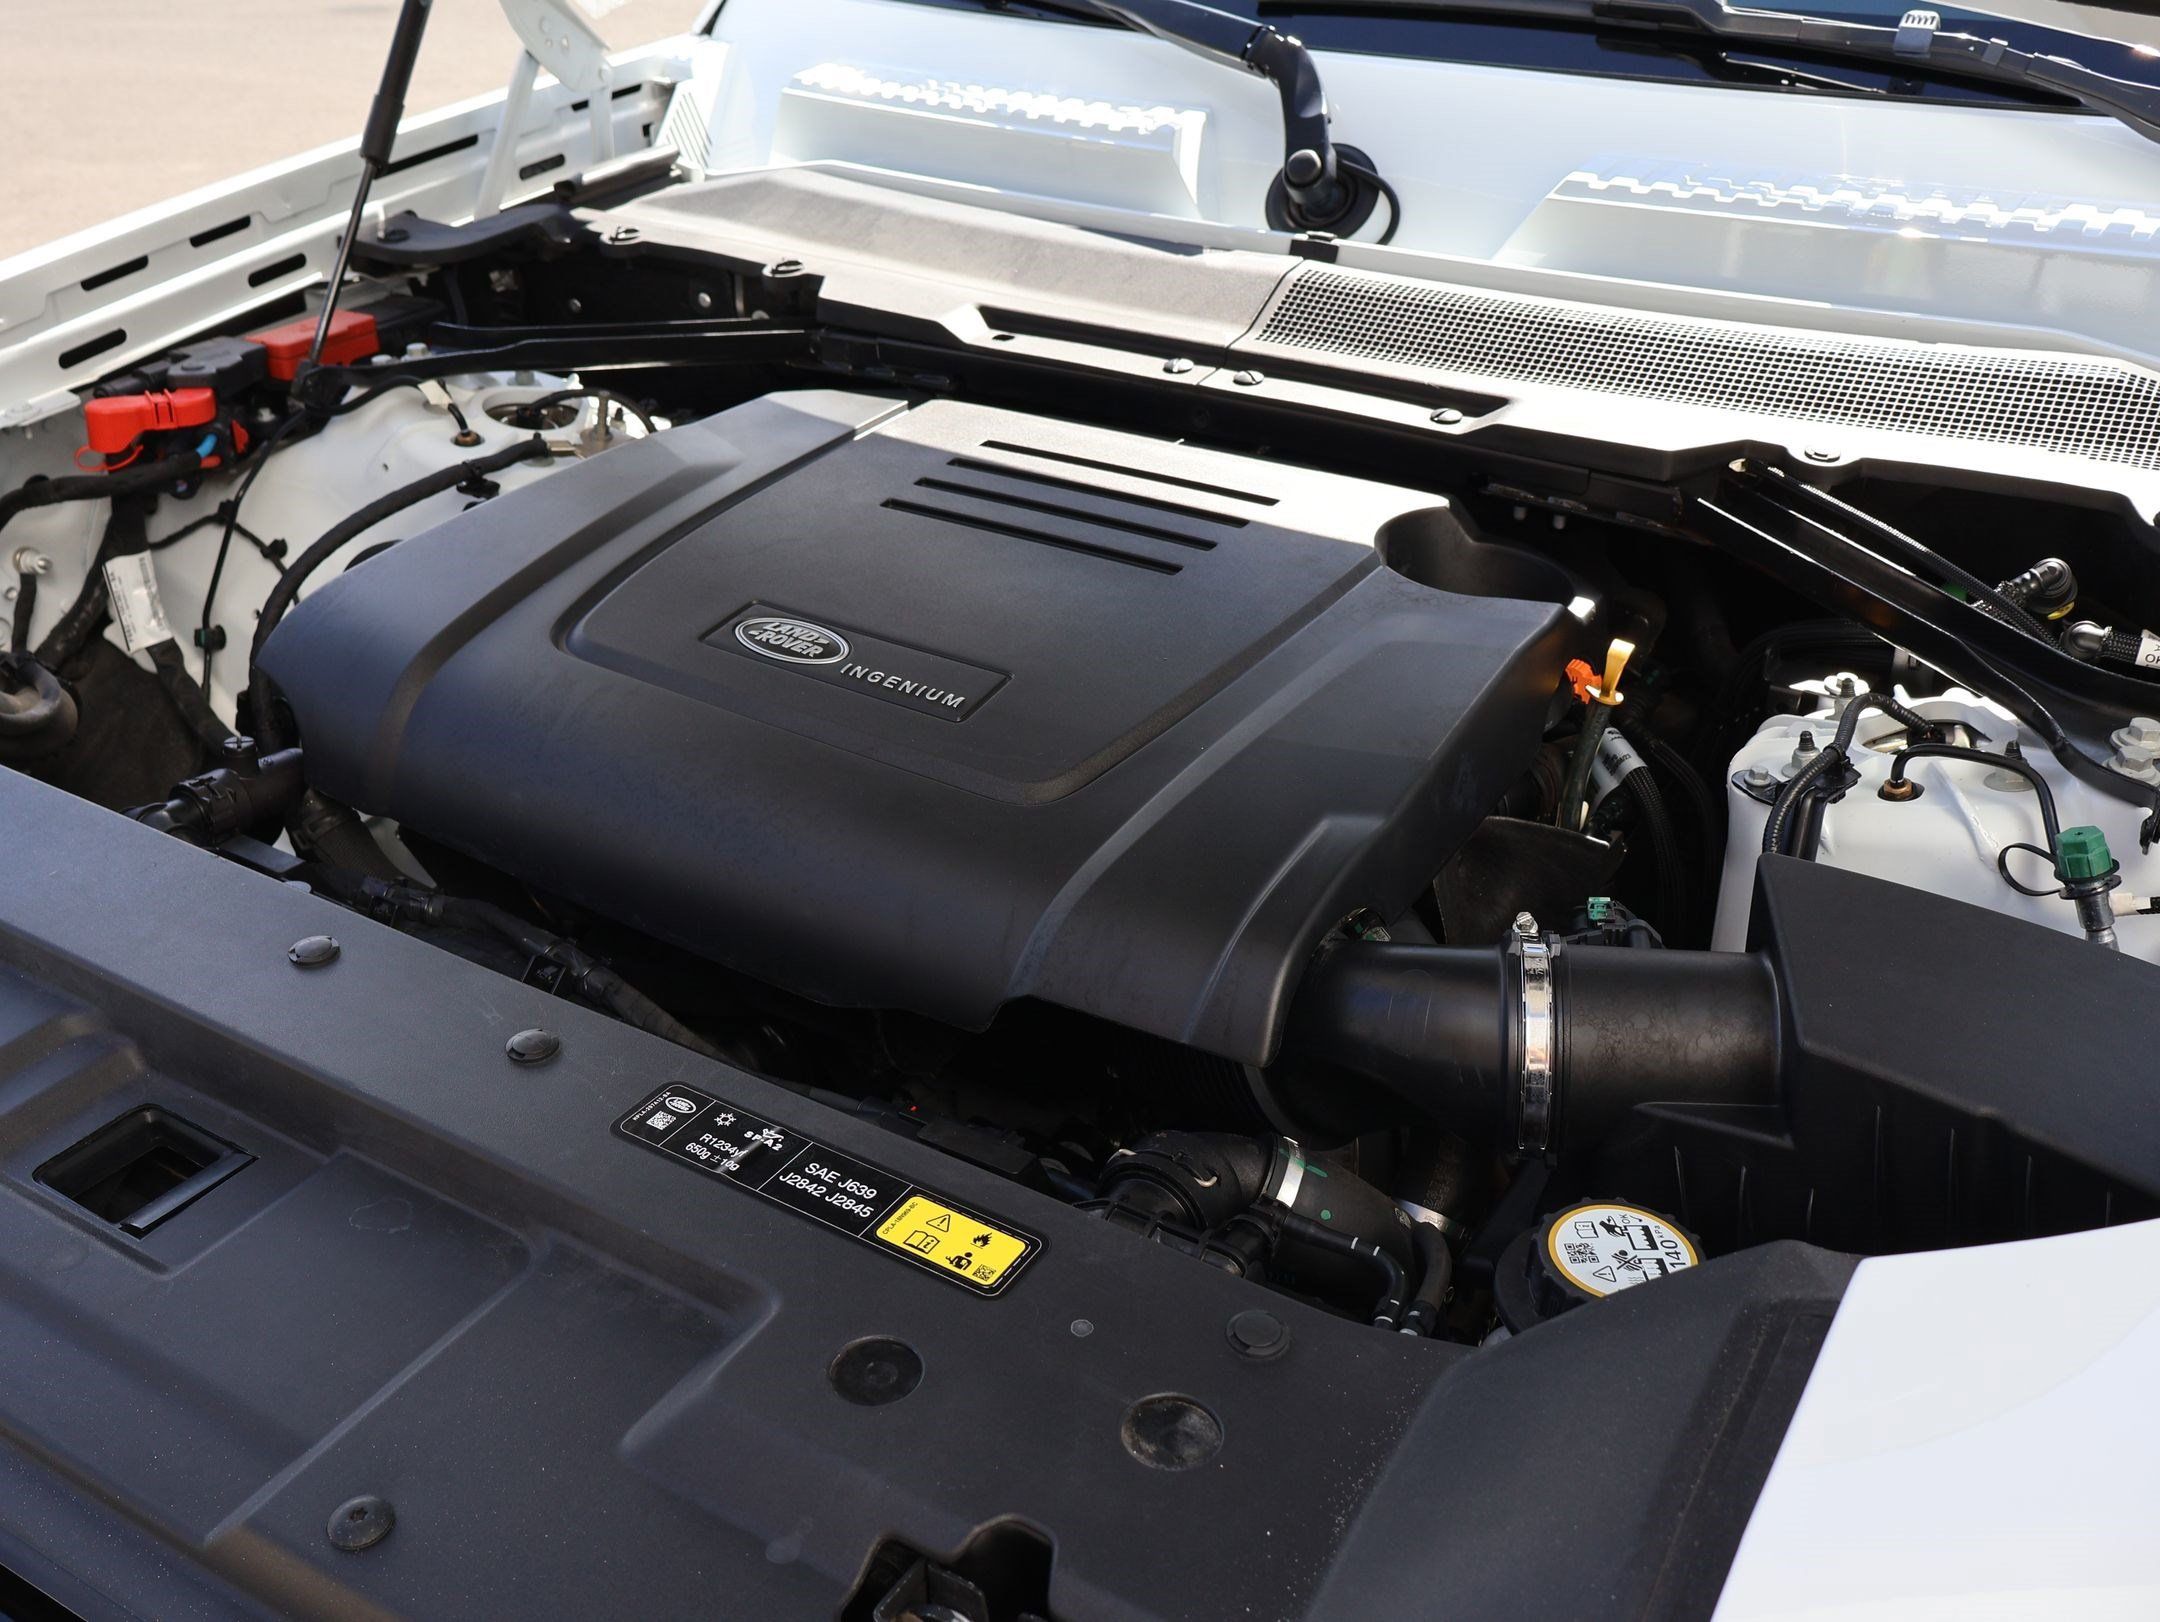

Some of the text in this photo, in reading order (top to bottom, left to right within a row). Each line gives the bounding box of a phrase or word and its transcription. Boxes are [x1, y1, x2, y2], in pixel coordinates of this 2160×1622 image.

[758, 630, 824, 658] ROVER
[762, 622, 820, 642] LAND
[840, 662, 967, 709] INGENIUM
[685, 1142, 711, 1160] 650g
[699, 1133, 749, 1157] R1234yf
[779, 1172, 874, 1218] J2842 J2845
[804, 1162, 878, 1200] SAE J639
[1619, 1213, 1631, 1225] OK
[1660, 1240, 1687, 1268] 140
